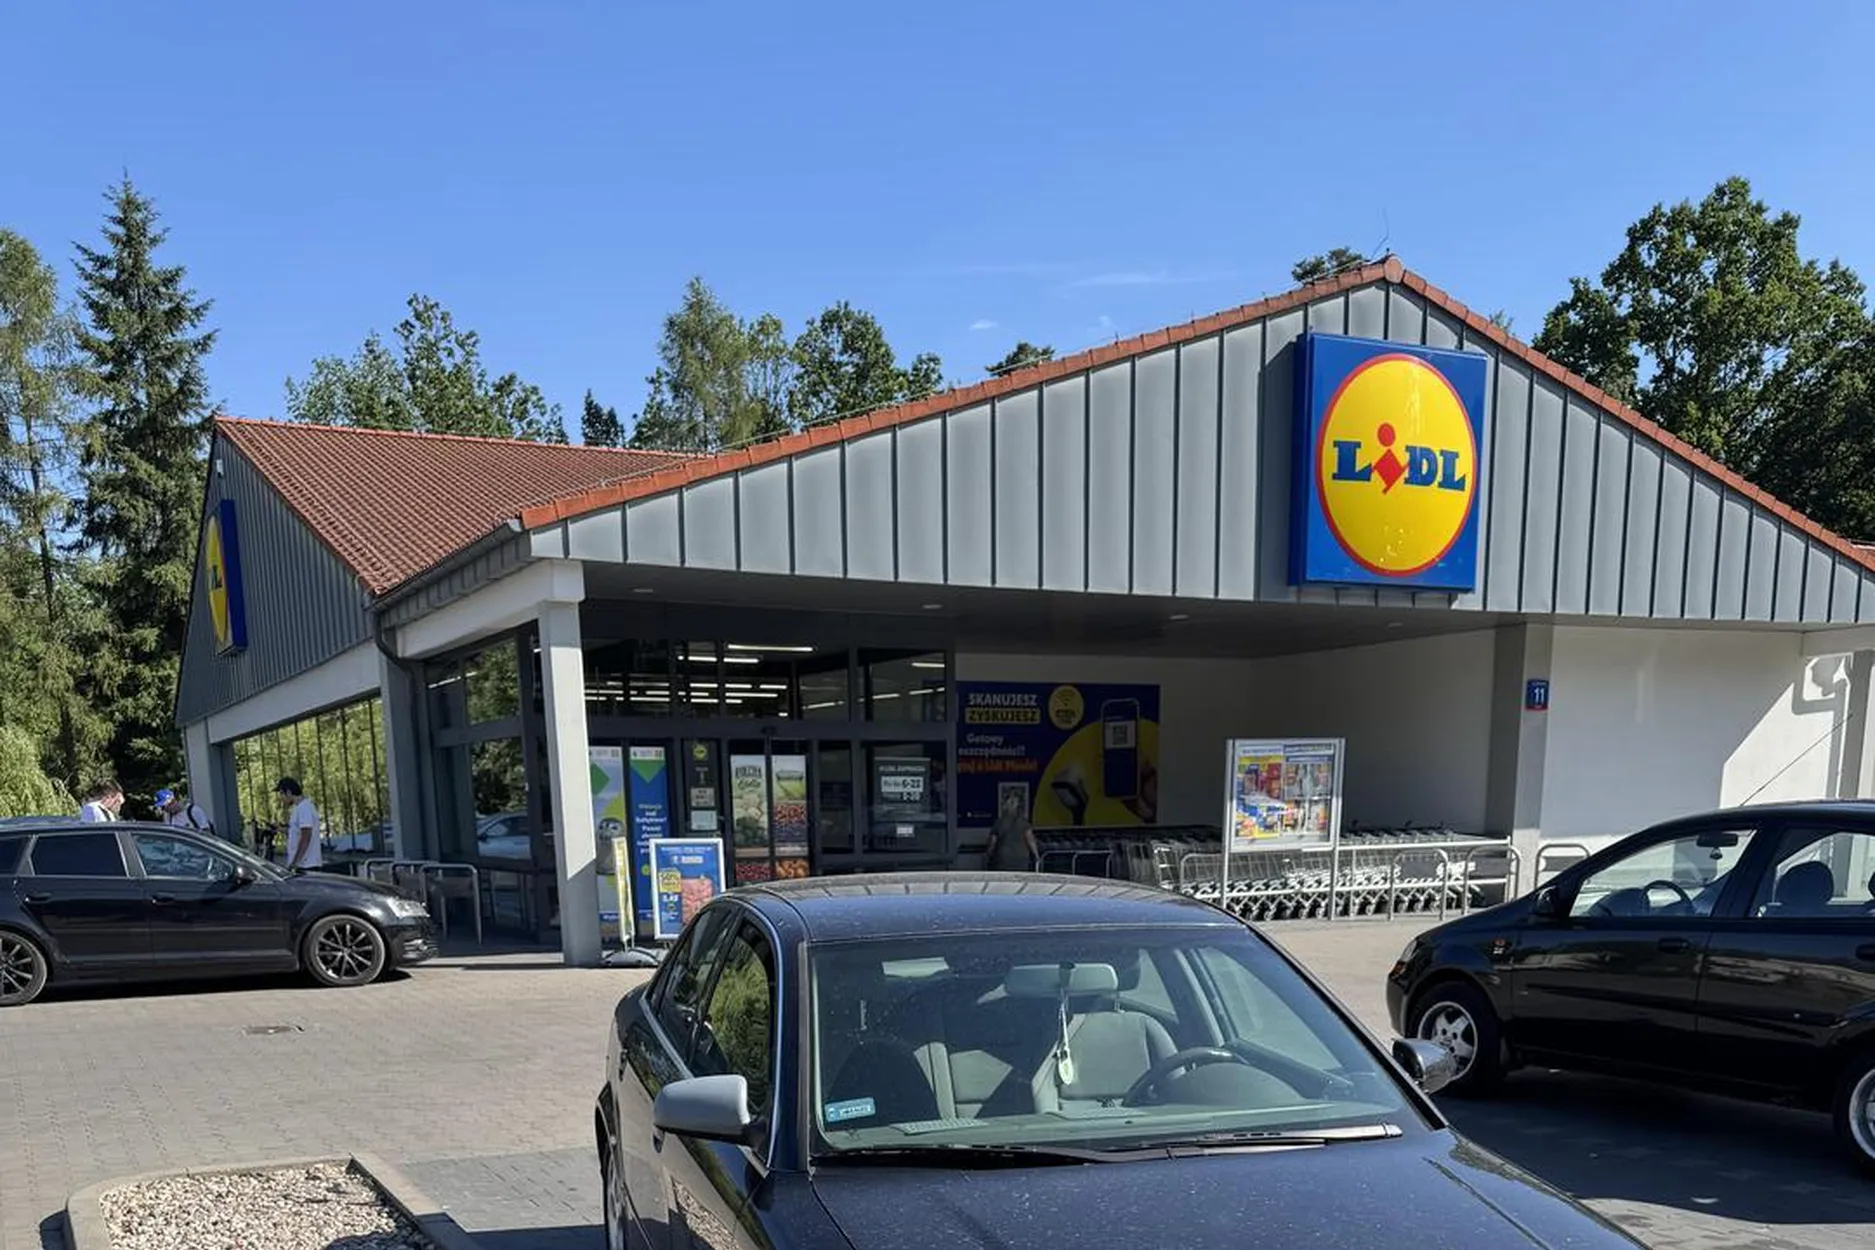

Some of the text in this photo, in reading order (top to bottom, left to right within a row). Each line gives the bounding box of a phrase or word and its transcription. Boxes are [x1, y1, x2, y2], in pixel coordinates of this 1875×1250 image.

[968, 693, 1038, 706] SKANUJESZ
[1533, 686, 1545, 704] 11
[968, 709, 1038, 722] ZYSKUJESZ
